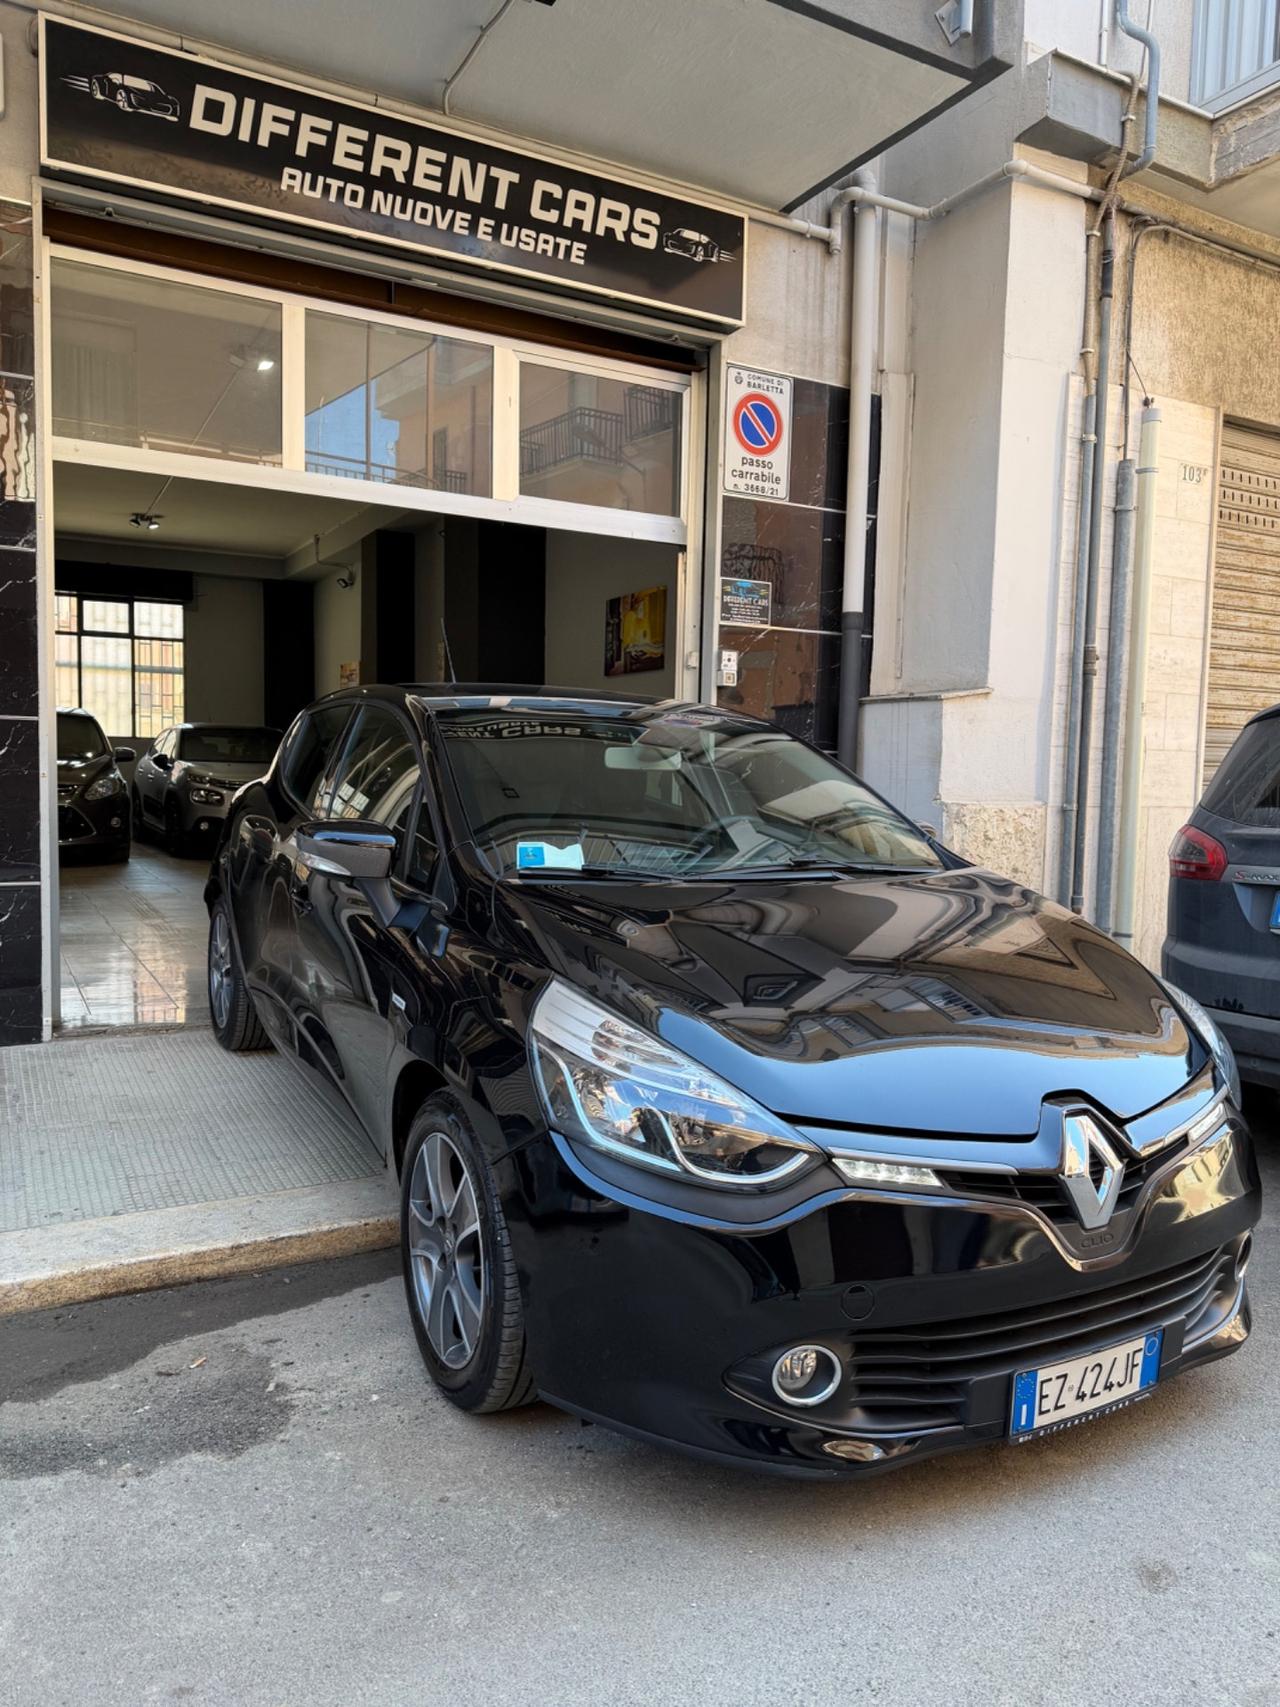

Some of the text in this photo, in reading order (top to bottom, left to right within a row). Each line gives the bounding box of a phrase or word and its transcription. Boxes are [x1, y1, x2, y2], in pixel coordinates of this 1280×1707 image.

[189, 84, 661, 250] DIFFERENT CARS
[281, 167, 588, 265] AUTO NUOVE E USATE
[747, 373, 774, 384] COMUNE
[747, 381, 784, 395] BARLETTA
[741, 456, 773, 470] passo
[731, 468, 782, 485] carrabile
[1081, 1232, 1114, 1248] CLIO
